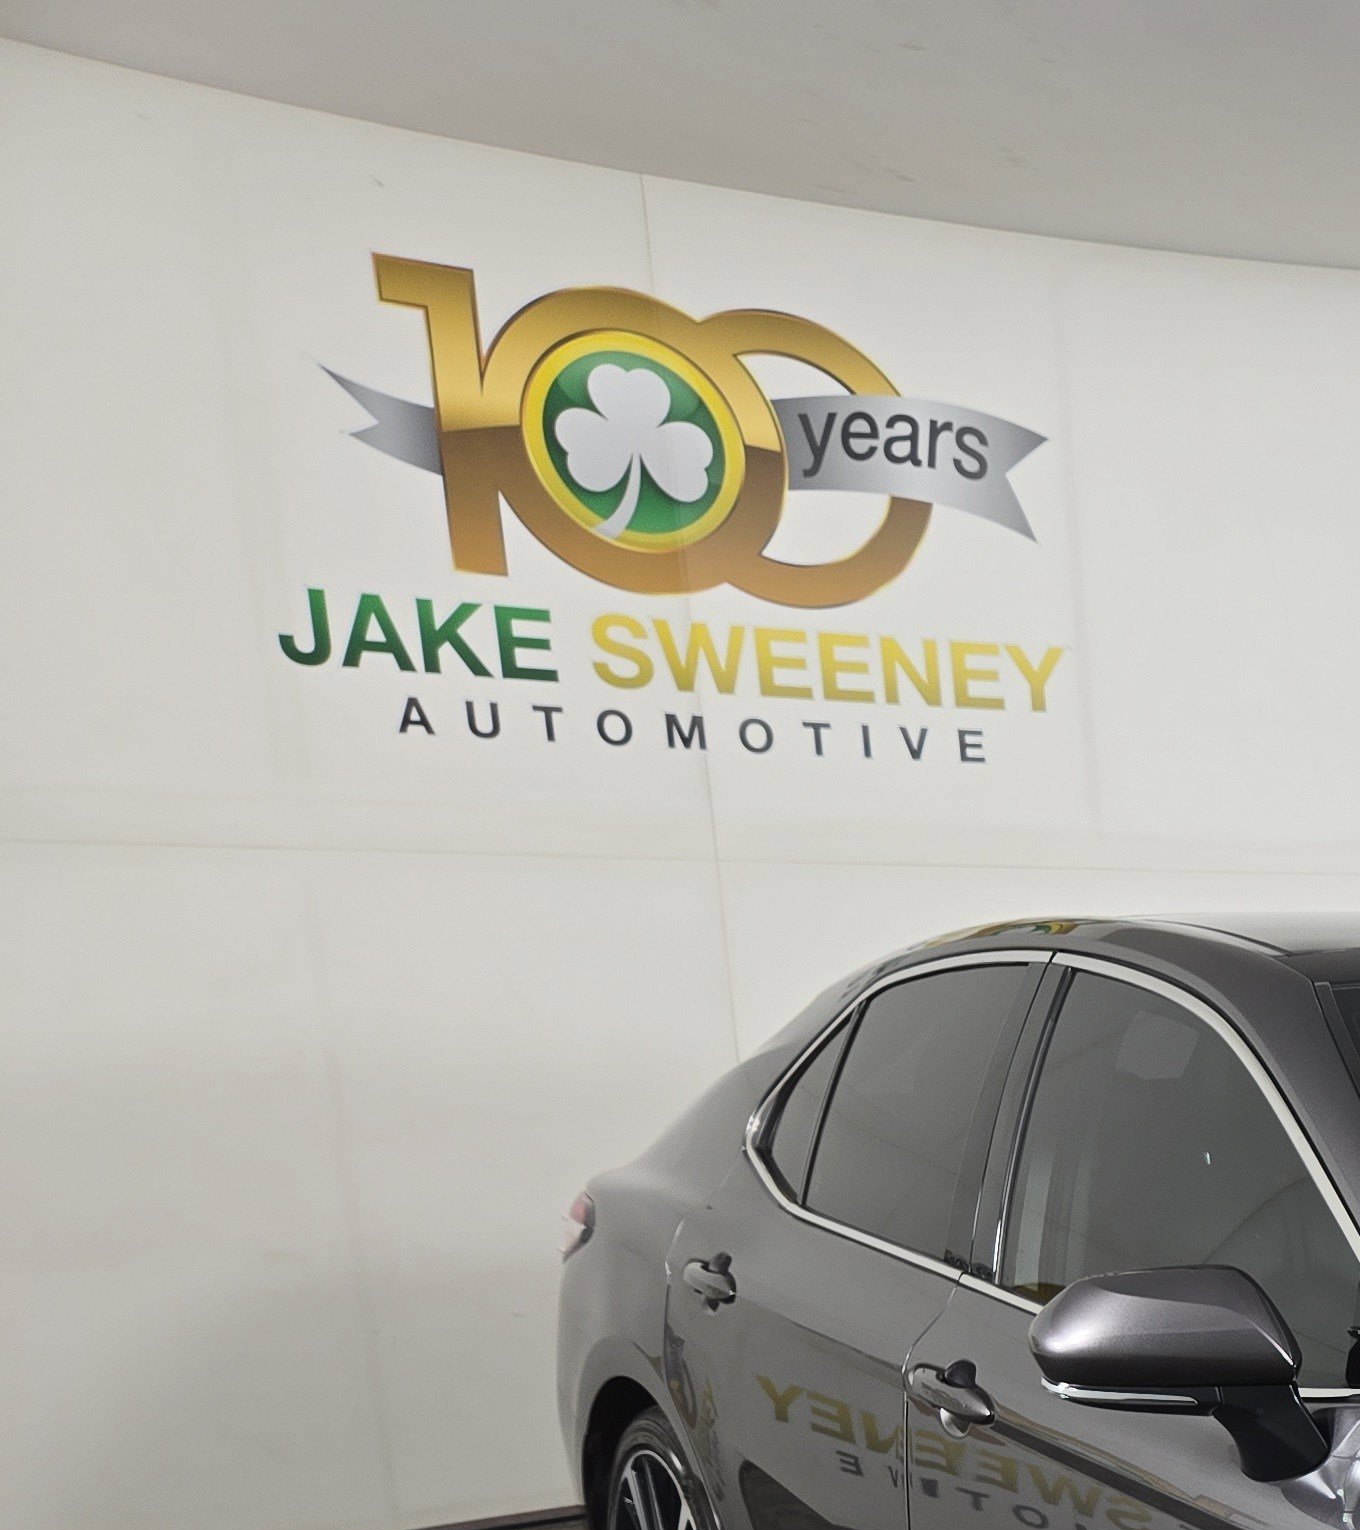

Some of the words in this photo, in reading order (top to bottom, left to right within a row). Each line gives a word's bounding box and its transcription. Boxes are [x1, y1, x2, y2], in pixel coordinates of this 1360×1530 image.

[372, 252, 933, 610] 100
[798, 406, 990, 481] years
[277, 587, 560, 682] JAKE
[590, 613, 1065, 713] SWEENEY
[397, 695, 988, 764] AUTOMOTIVE
